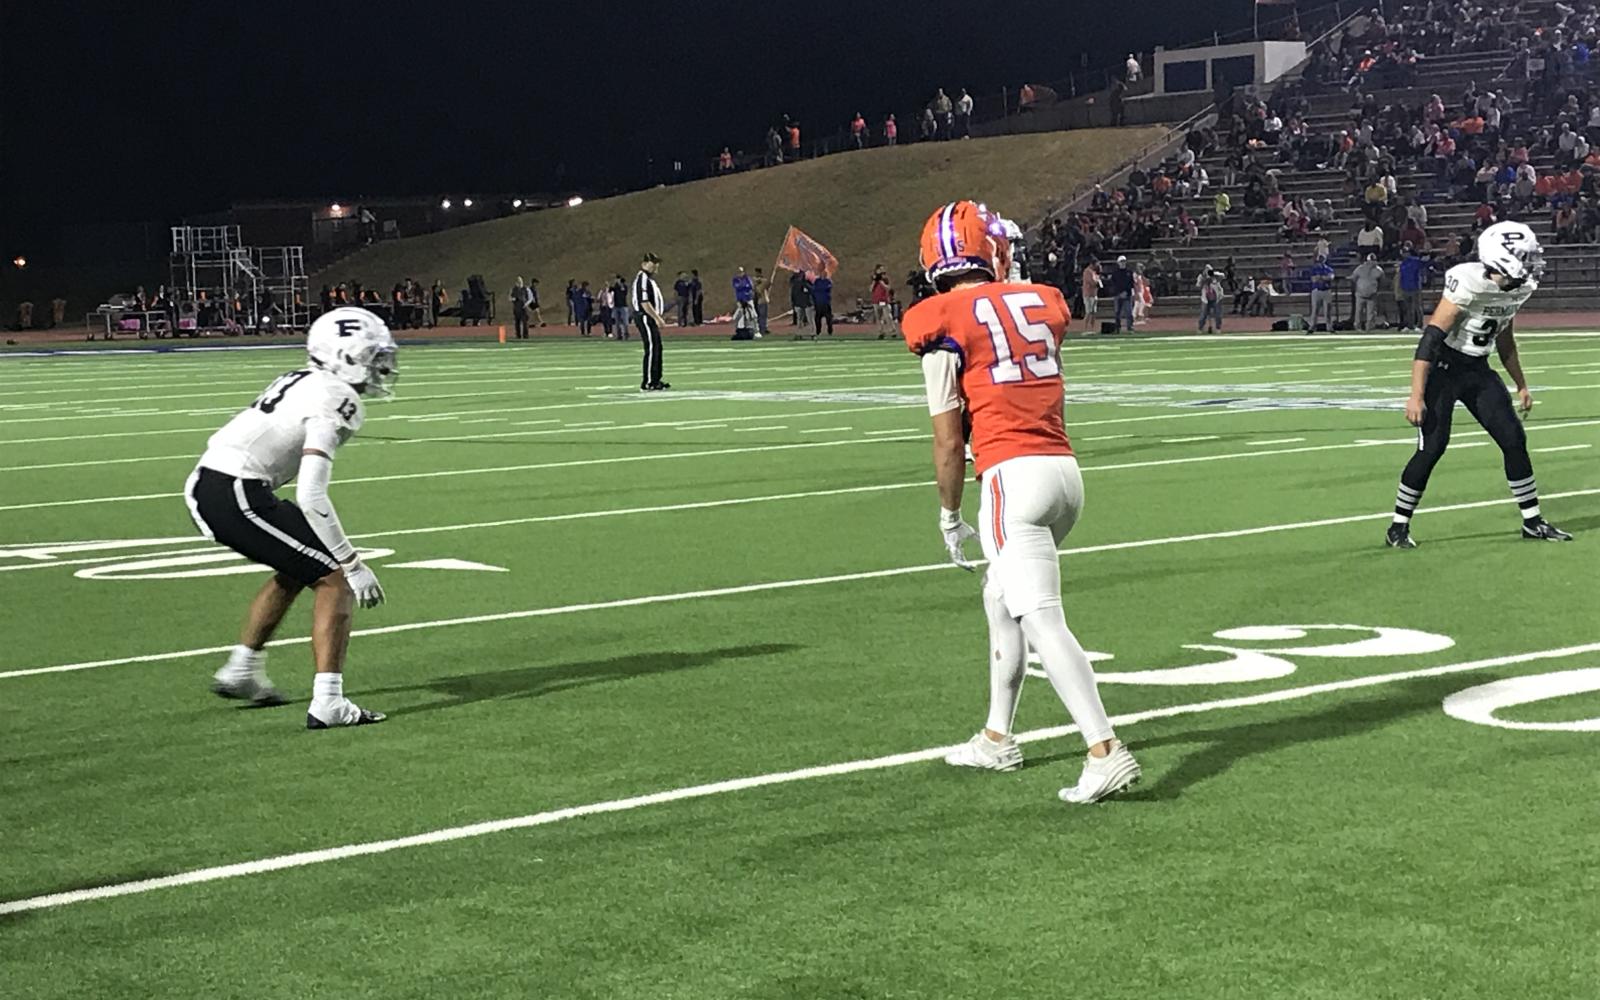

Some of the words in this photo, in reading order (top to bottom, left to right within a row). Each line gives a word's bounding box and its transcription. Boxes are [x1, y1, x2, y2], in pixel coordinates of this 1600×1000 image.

[1445, 275, 1459, 293] 30
[973, 291, 1060, 384] 15
[336, 398, 357, 421] 13
